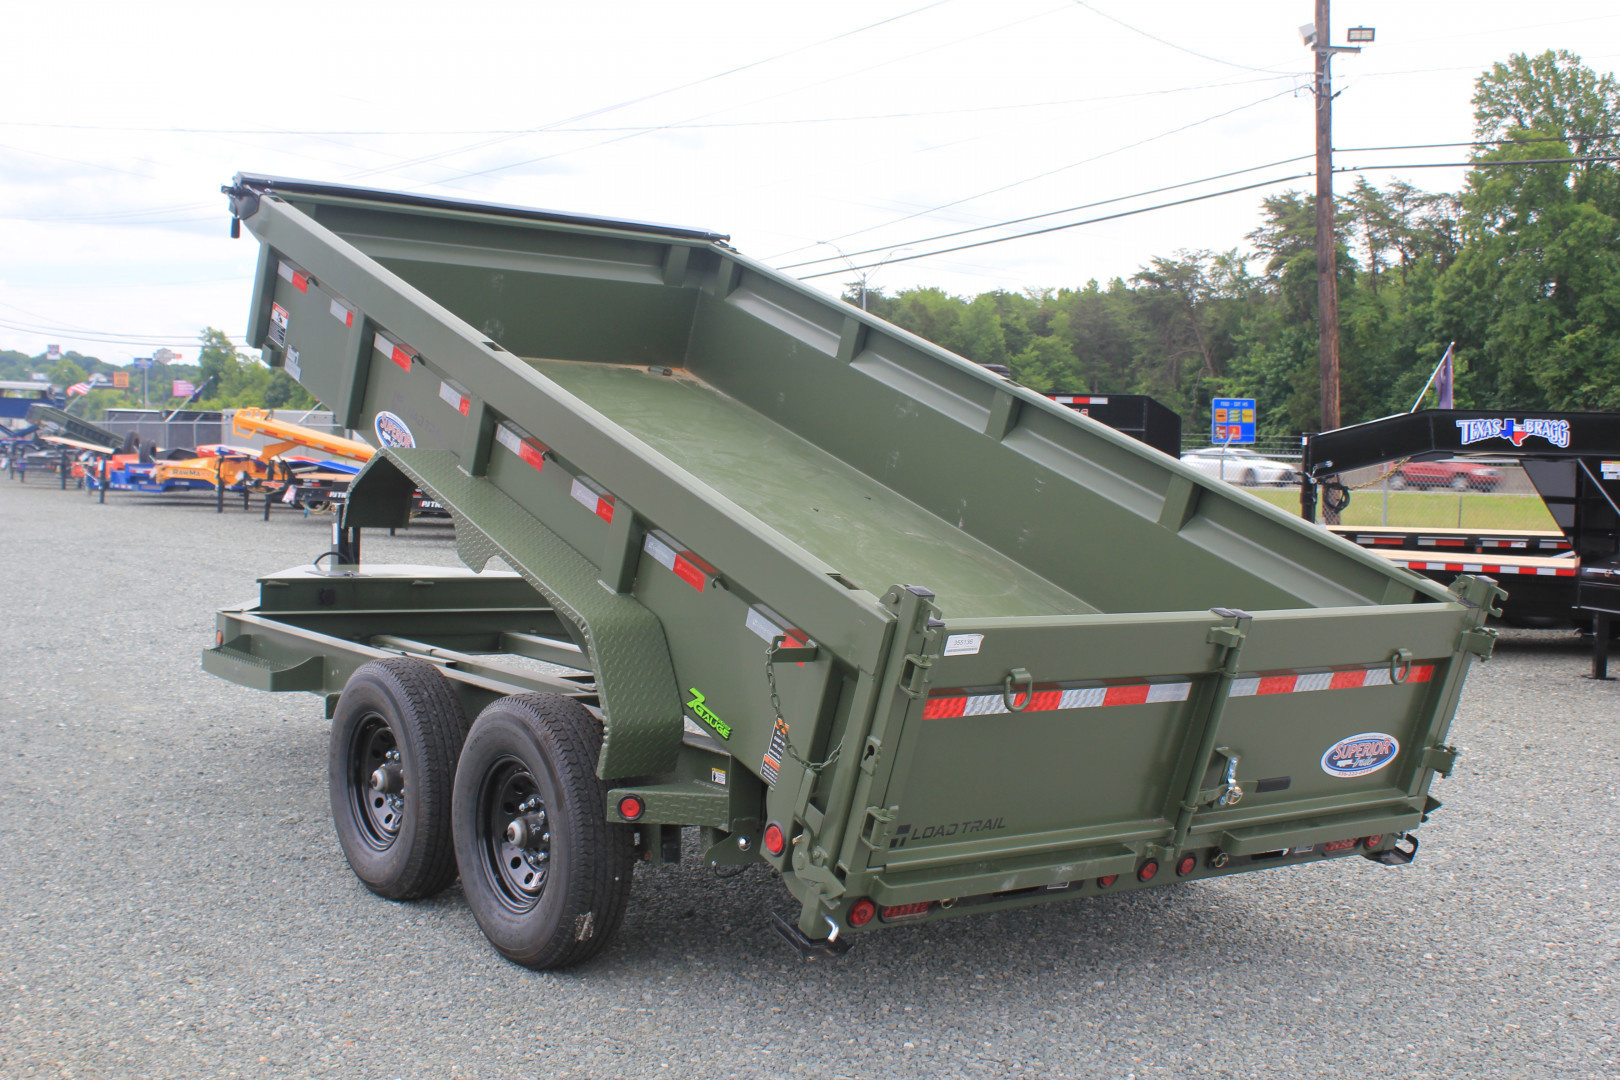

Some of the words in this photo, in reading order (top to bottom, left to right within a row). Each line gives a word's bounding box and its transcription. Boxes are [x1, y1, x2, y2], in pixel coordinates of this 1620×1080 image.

[1455, 418, 1503, 445] TEXAS
[1523, 418, 1571, 448] BRAGG
[693, 701, 731, 740] GAUGE
[1333, 737, 1392, 760] SUPERIOR
[910, 823, 959, 841] LOAD
[962, 817, 1006, 834] TRAIL
